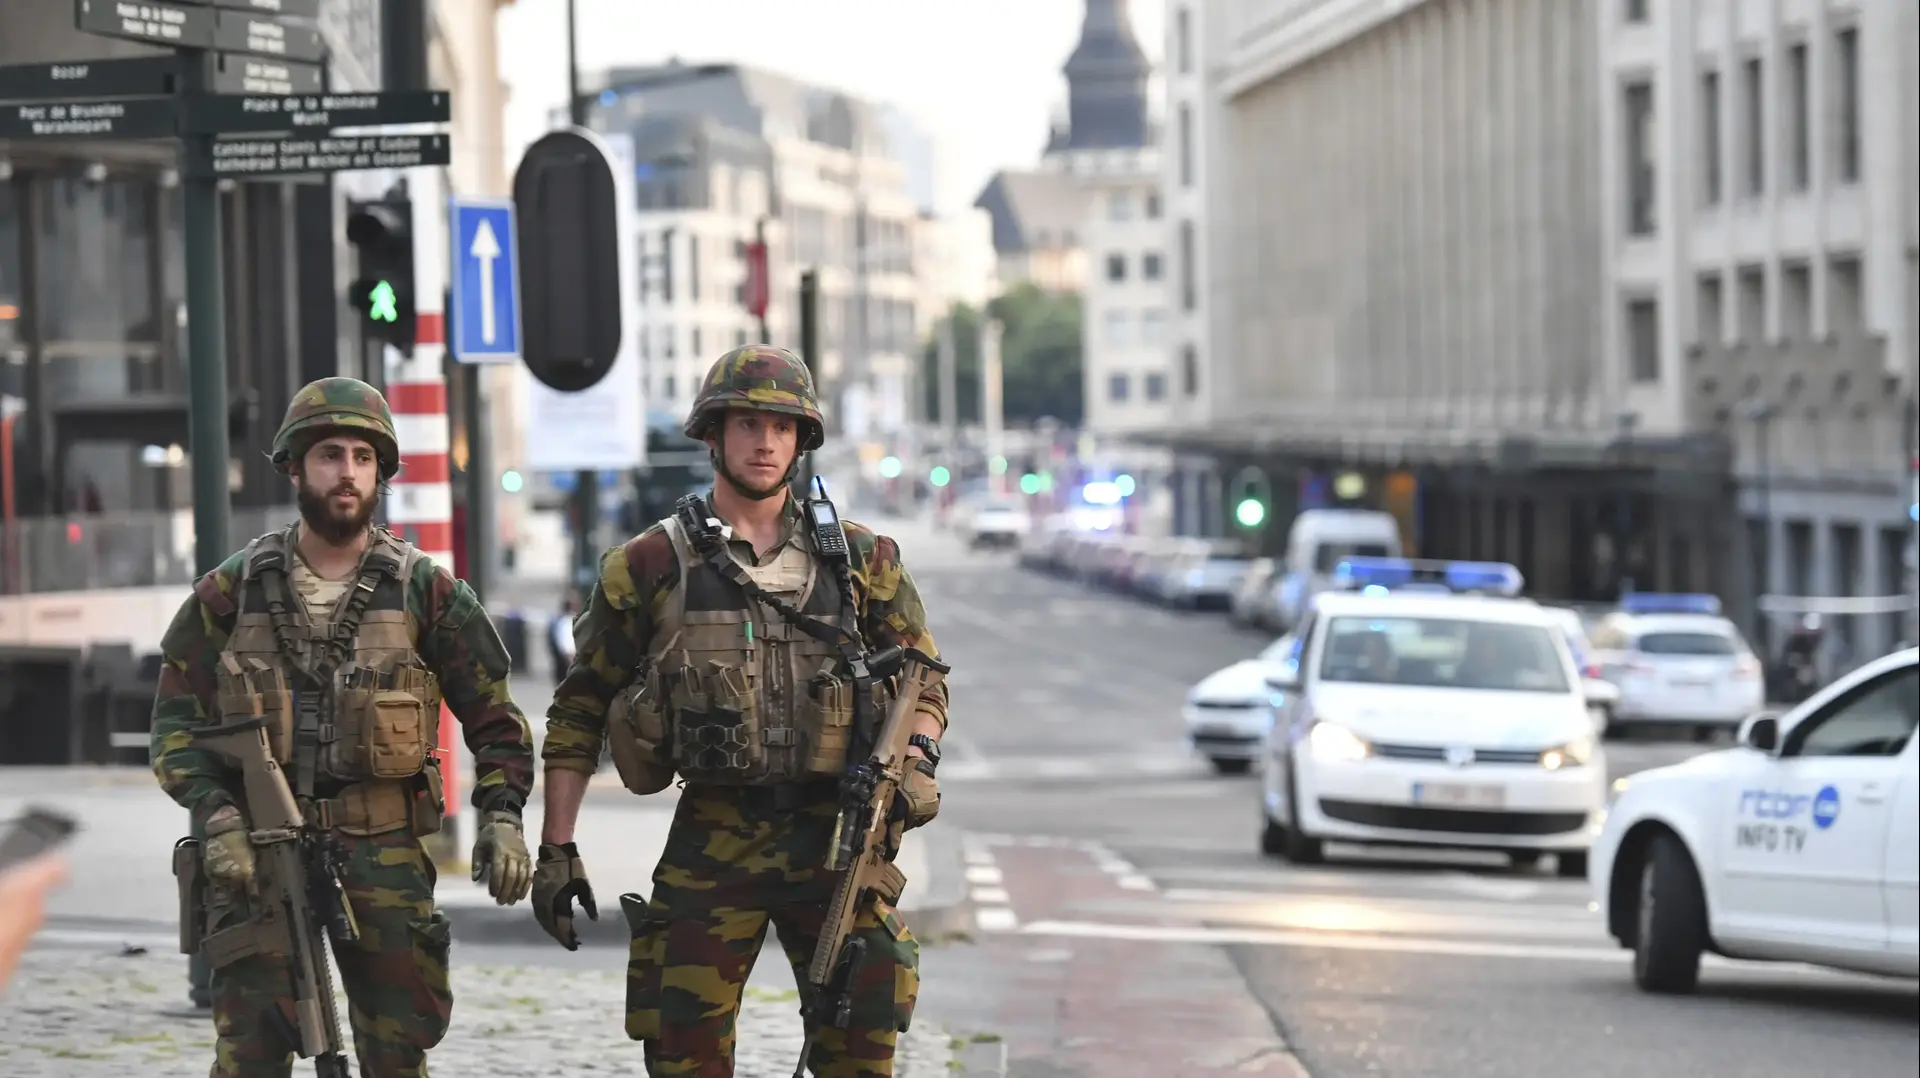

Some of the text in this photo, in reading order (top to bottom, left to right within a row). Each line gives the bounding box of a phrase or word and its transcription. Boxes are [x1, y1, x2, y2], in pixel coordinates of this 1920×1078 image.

[243, 96, 379, 112] Place de la Monnaie
[50, 106, 66, 119] de
[292, 111, 330, 126] Munt
[280, 141, 316, 155] Saints
[361, 138, 376, 152] et
[280, 155, 304, 170] Sint
[353, 153, 370, 167] en
[1735, 824, 1807, 854] INFO TV
